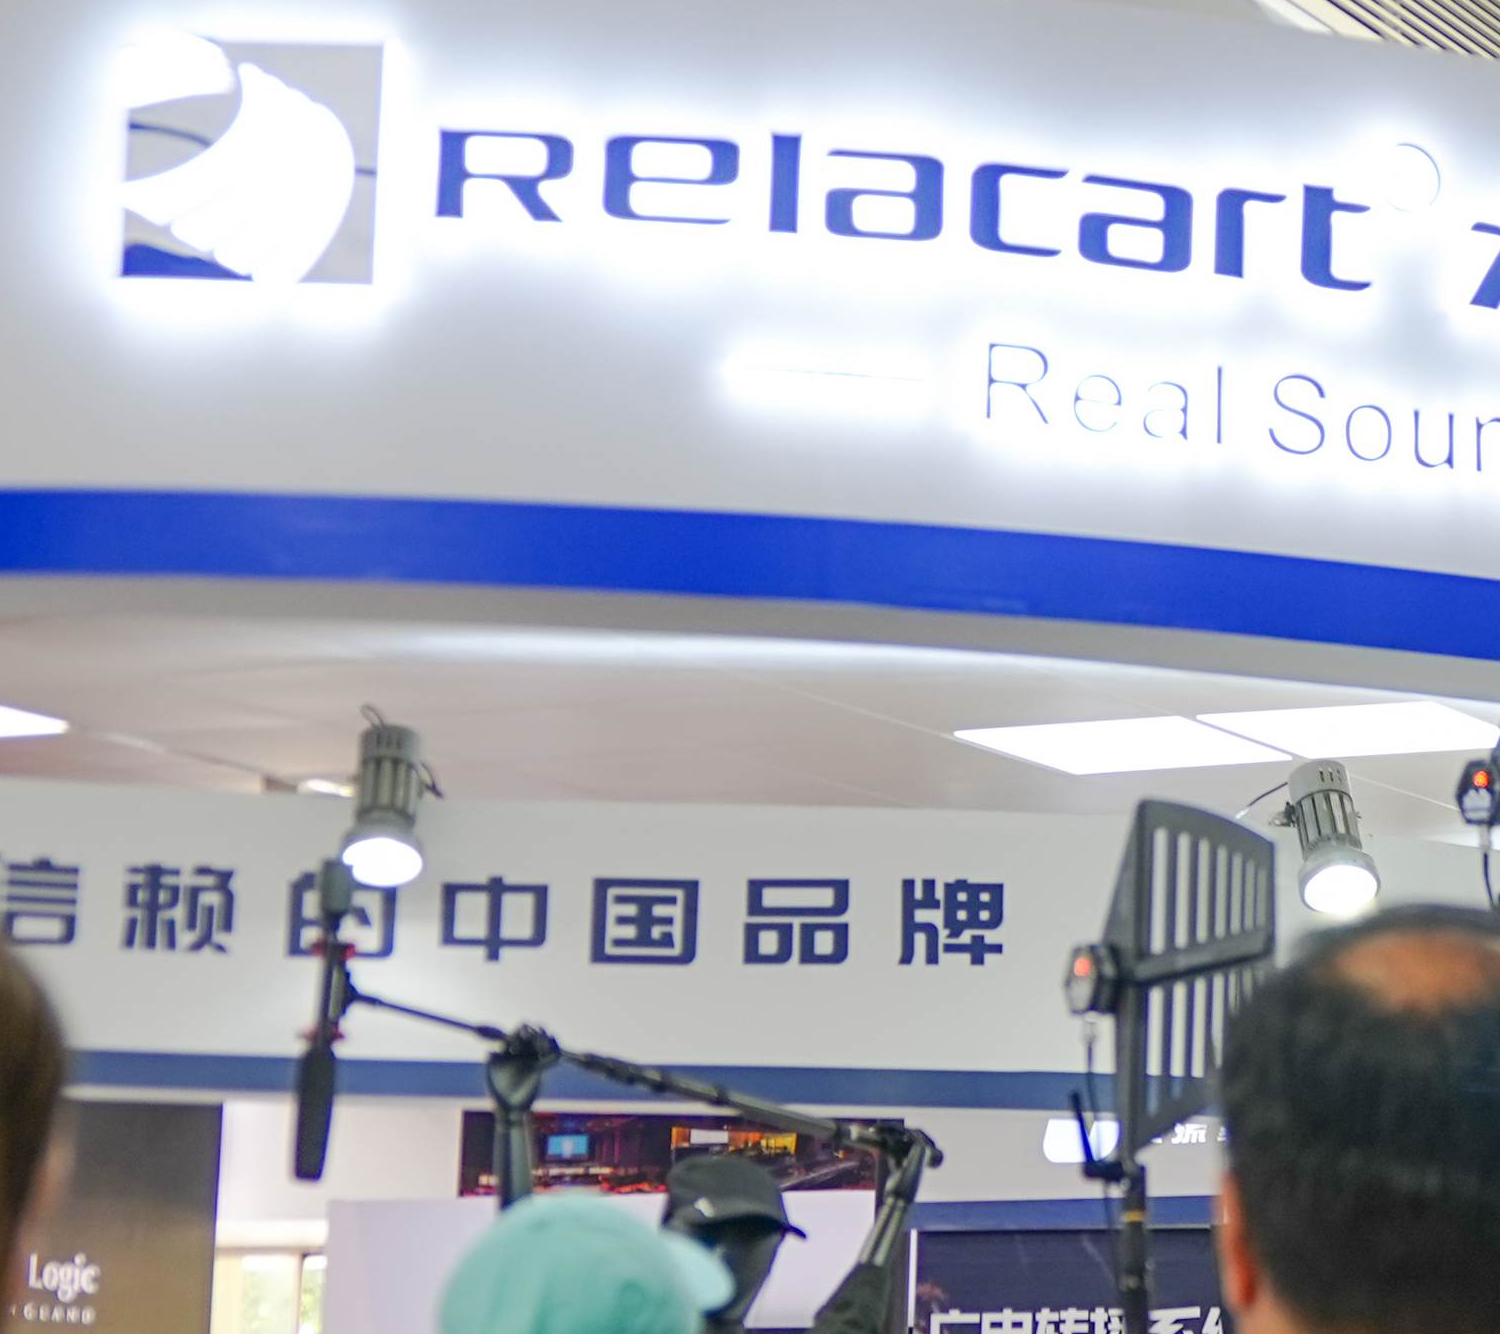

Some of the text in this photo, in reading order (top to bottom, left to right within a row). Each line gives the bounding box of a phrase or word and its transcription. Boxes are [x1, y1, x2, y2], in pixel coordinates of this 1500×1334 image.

[434, 126, 1376, 292] Relacart
[984, 341, 1228, 447] Real
[28, 1252, 101, 1304] Logic
